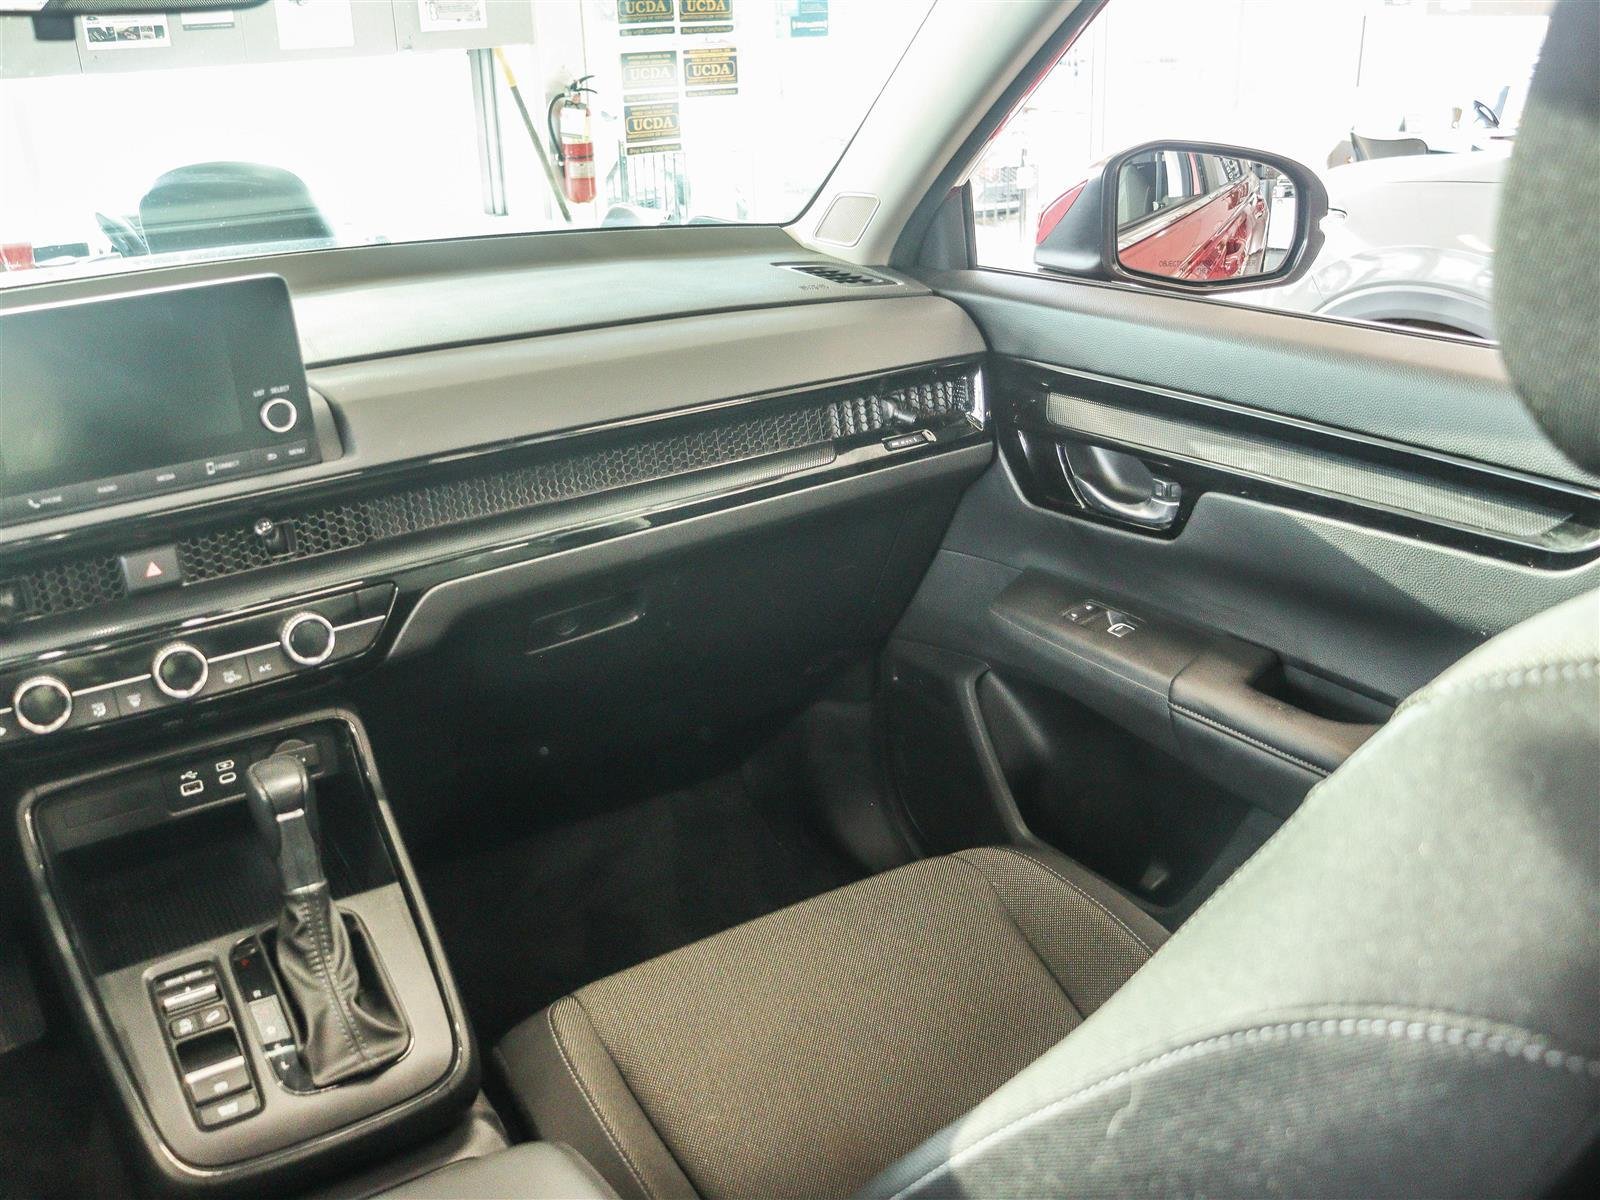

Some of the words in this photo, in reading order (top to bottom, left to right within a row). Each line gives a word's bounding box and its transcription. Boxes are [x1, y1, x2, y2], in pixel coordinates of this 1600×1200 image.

[625, 0, 667, 14] UCDA
[687, 0, 727, 12] UCDA
[628, 66, 671, 81] UCDA
[692, 64, 731, 77] UCDA
[632, 117, 674, 131] UCDA
